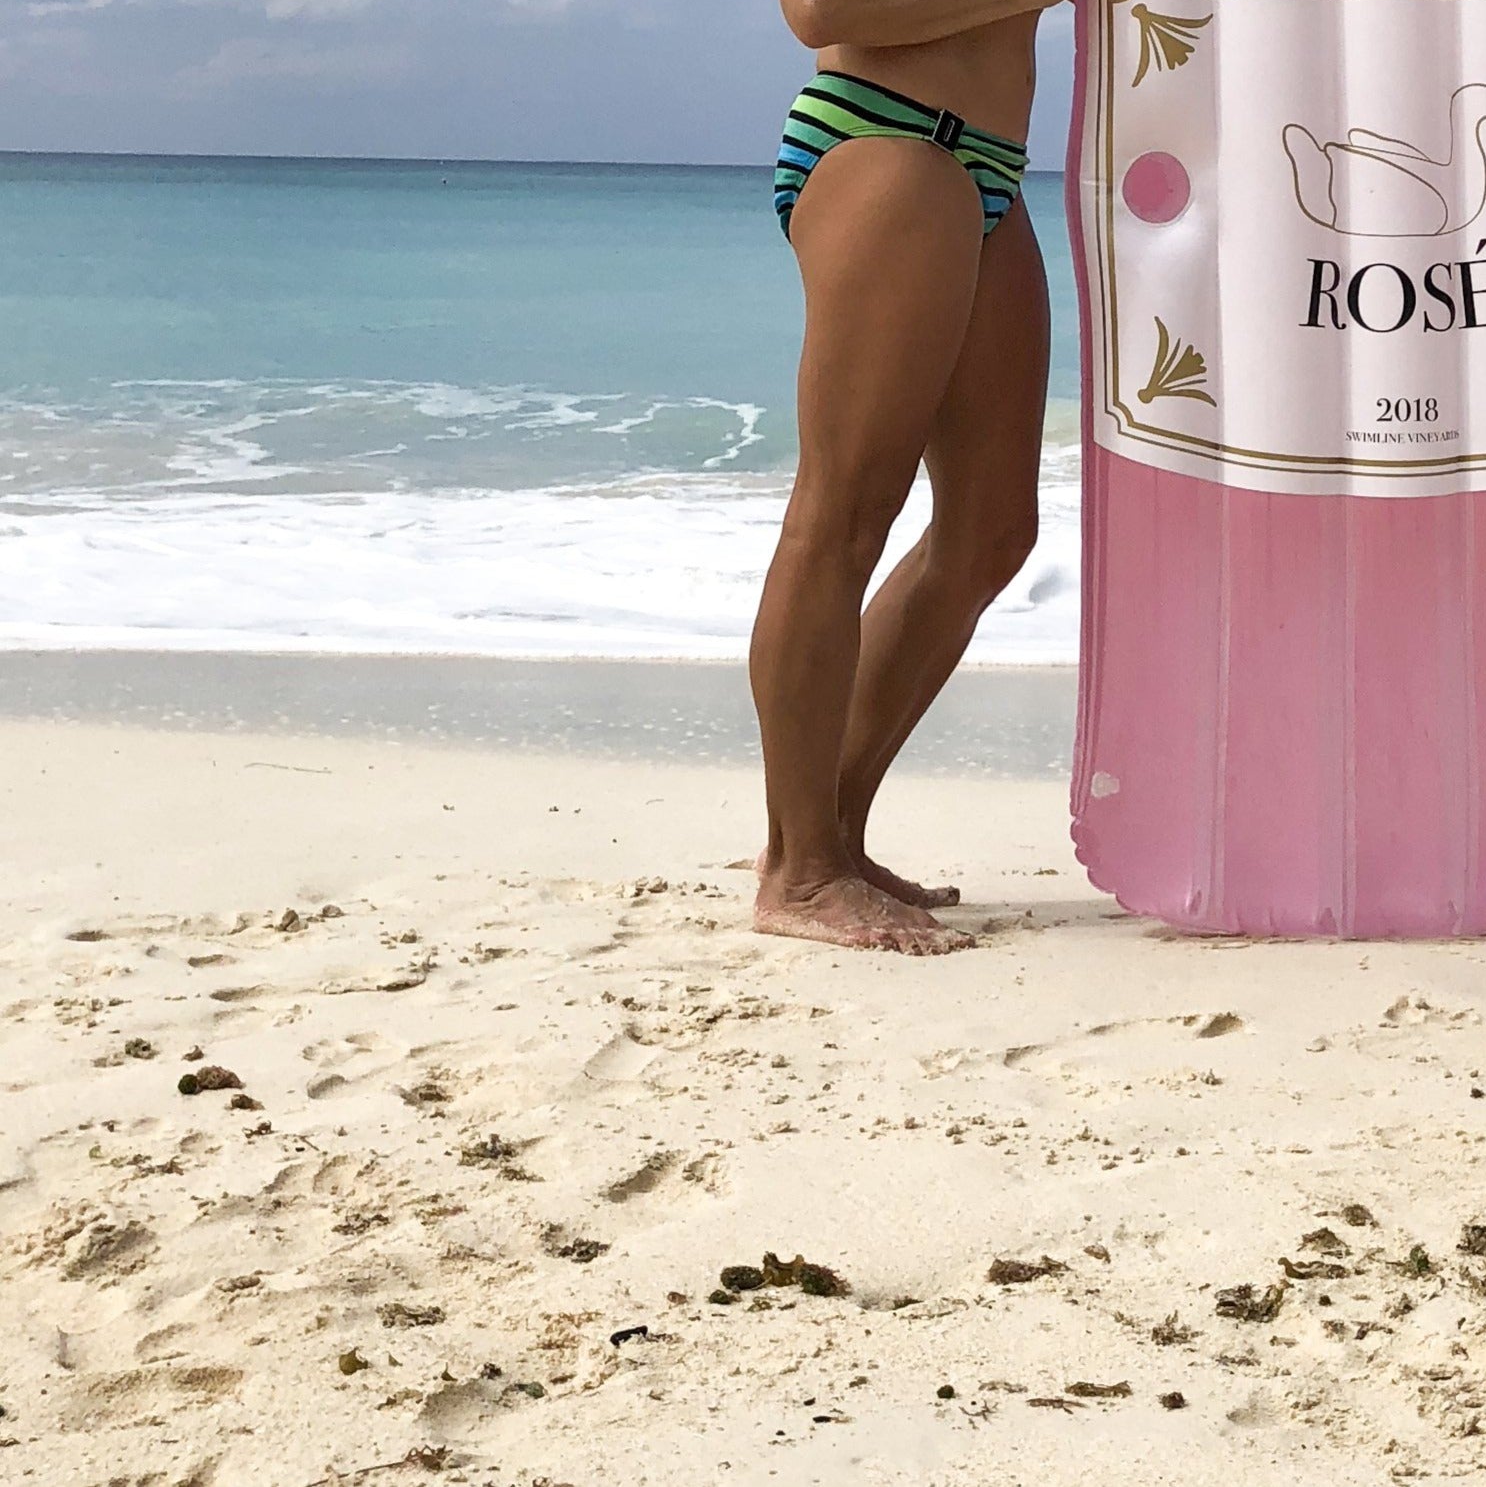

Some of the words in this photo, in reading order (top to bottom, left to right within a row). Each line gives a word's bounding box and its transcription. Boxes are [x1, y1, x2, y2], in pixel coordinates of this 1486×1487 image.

[1376, 398, 1439, 422] 2018
[1345, 430, 1405, 444] SWIMLINE
[1407, 428, 1460, 443] VINEYARDS
